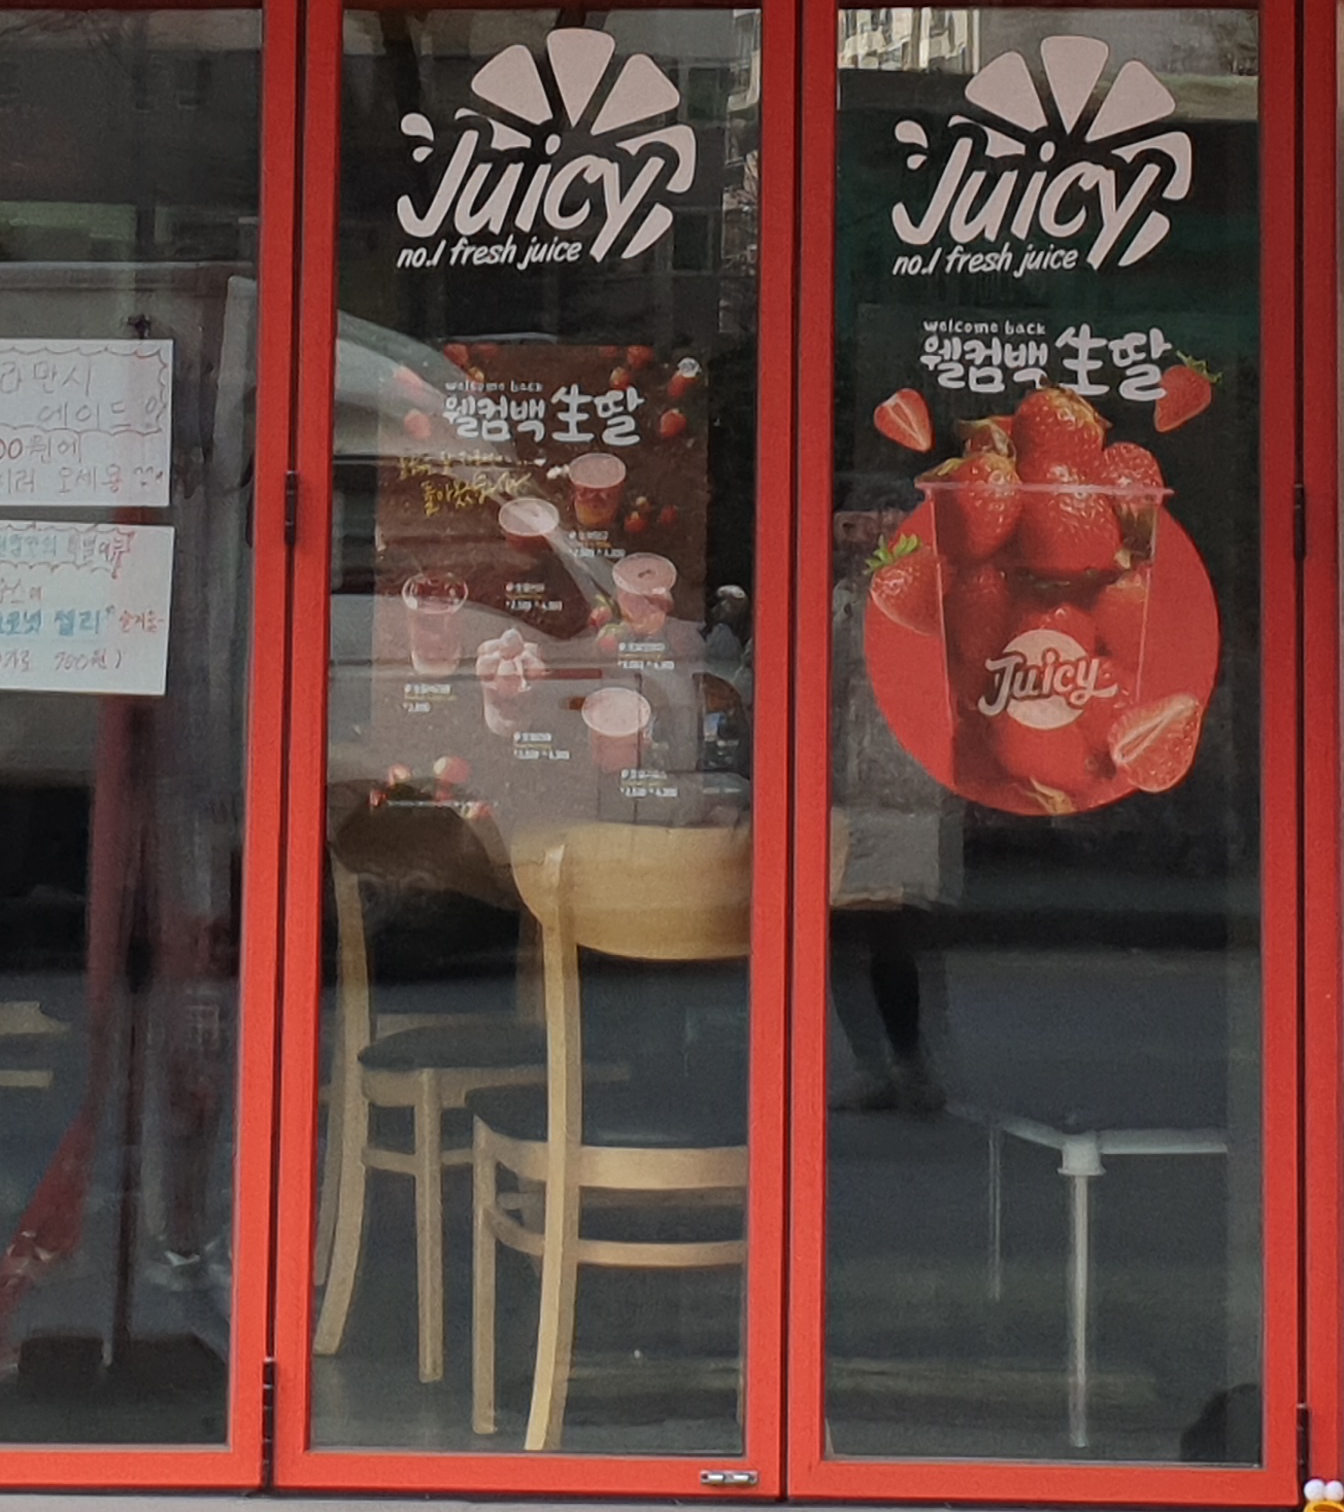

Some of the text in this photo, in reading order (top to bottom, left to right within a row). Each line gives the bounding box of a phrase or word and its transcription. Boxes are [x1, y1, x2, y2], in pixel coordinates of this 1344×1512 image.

[397, 130, 665, 263] Juicy
[892, 137, 1160, 270] Juicy
[450, 238, 516, 266] fresh
[516, 236, 583, 271] juice
[945, 243, 1011, 274] fresh
[1013, 244, 1079, 277] juice
[923, 319, 1046, 335] welcome back
[920, 335, 1048, 393] 웰컴백
[443, 394, 547, 443] 웰컴백
[978, 649, 1119, 717] Juicy
